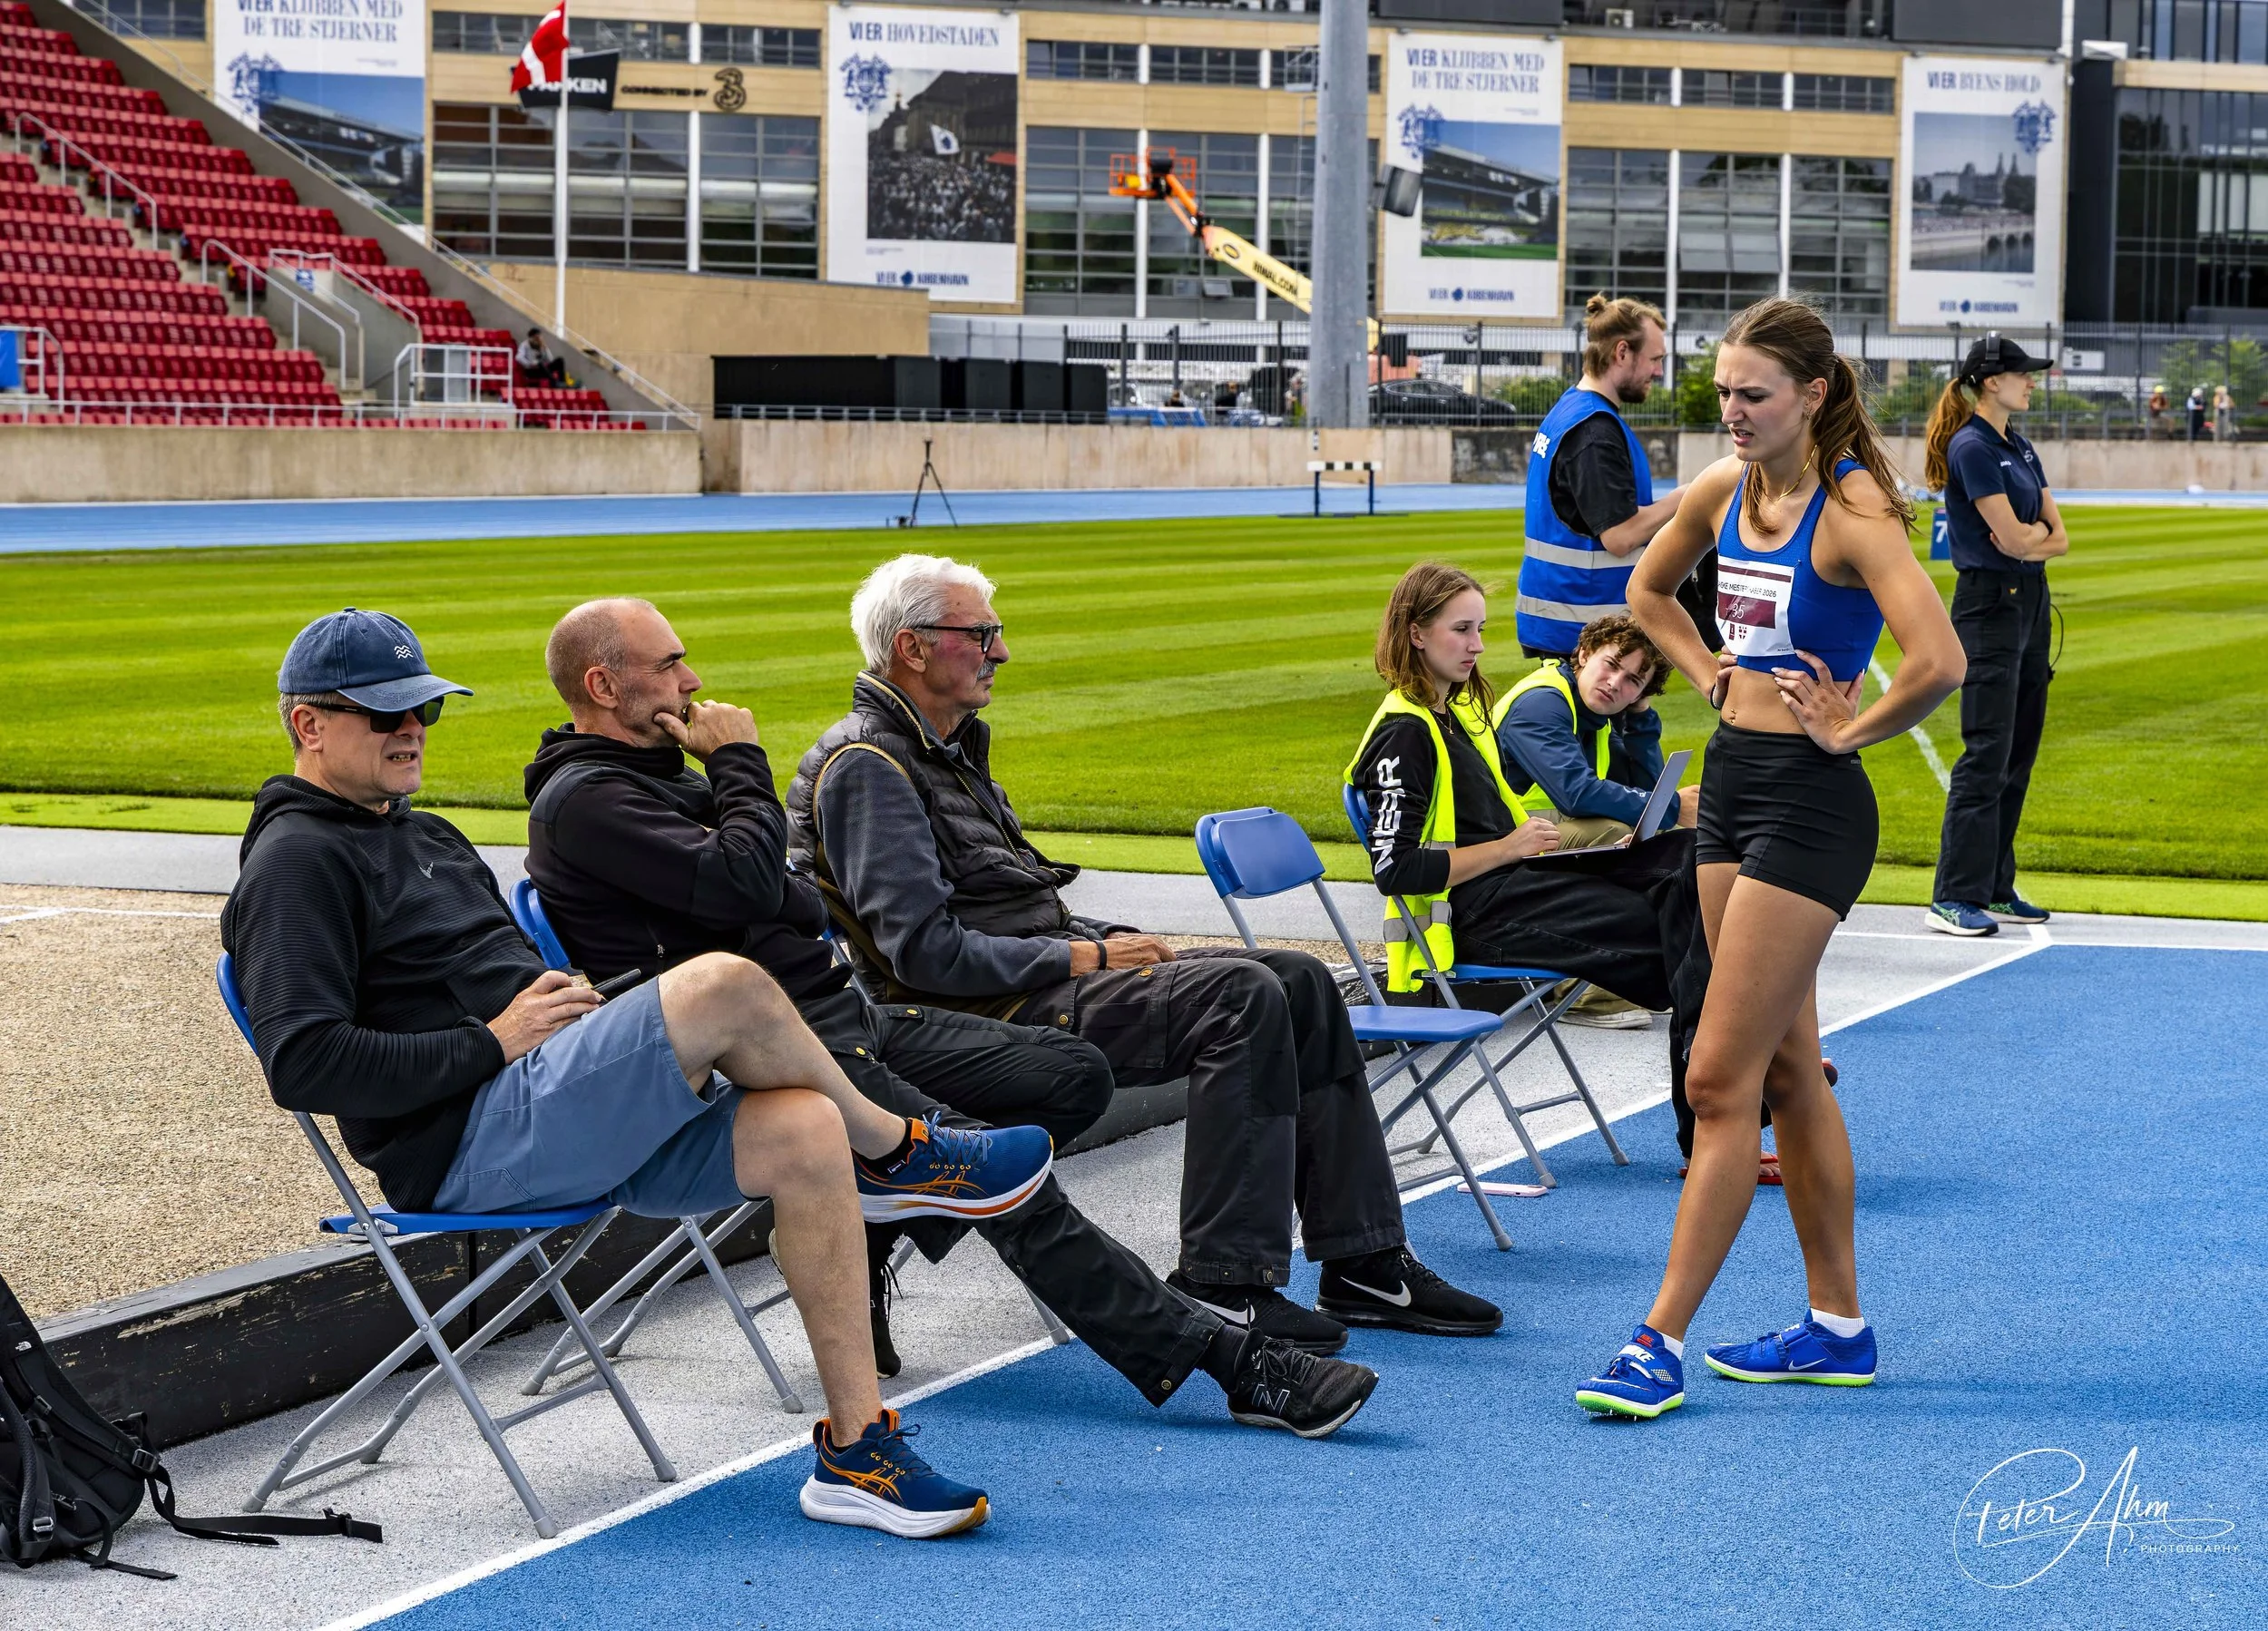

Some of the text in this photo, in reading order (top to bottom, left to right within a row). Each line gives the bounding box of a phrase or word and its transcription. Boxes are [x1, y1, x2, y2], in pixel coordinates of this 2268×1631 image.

[363, 0, 403, 18] MED
[244, 16, 397, 42] DE TRE STJERNER
[887, 23, 999, 46] HOVEDSTADEN
[1442, 49, 1509, 70] KLUBBEN
[1513, 53, 1545, 72] MED
[1412, 70, 1539, 93] DE TRE STJERNER
[1960, 72, 2002, 91] BYENS
[2004, 73, 2040, 93] HOLD
[1934, 520, 1948, 543] 7
[1762, 589, 1777, 598] 2026
